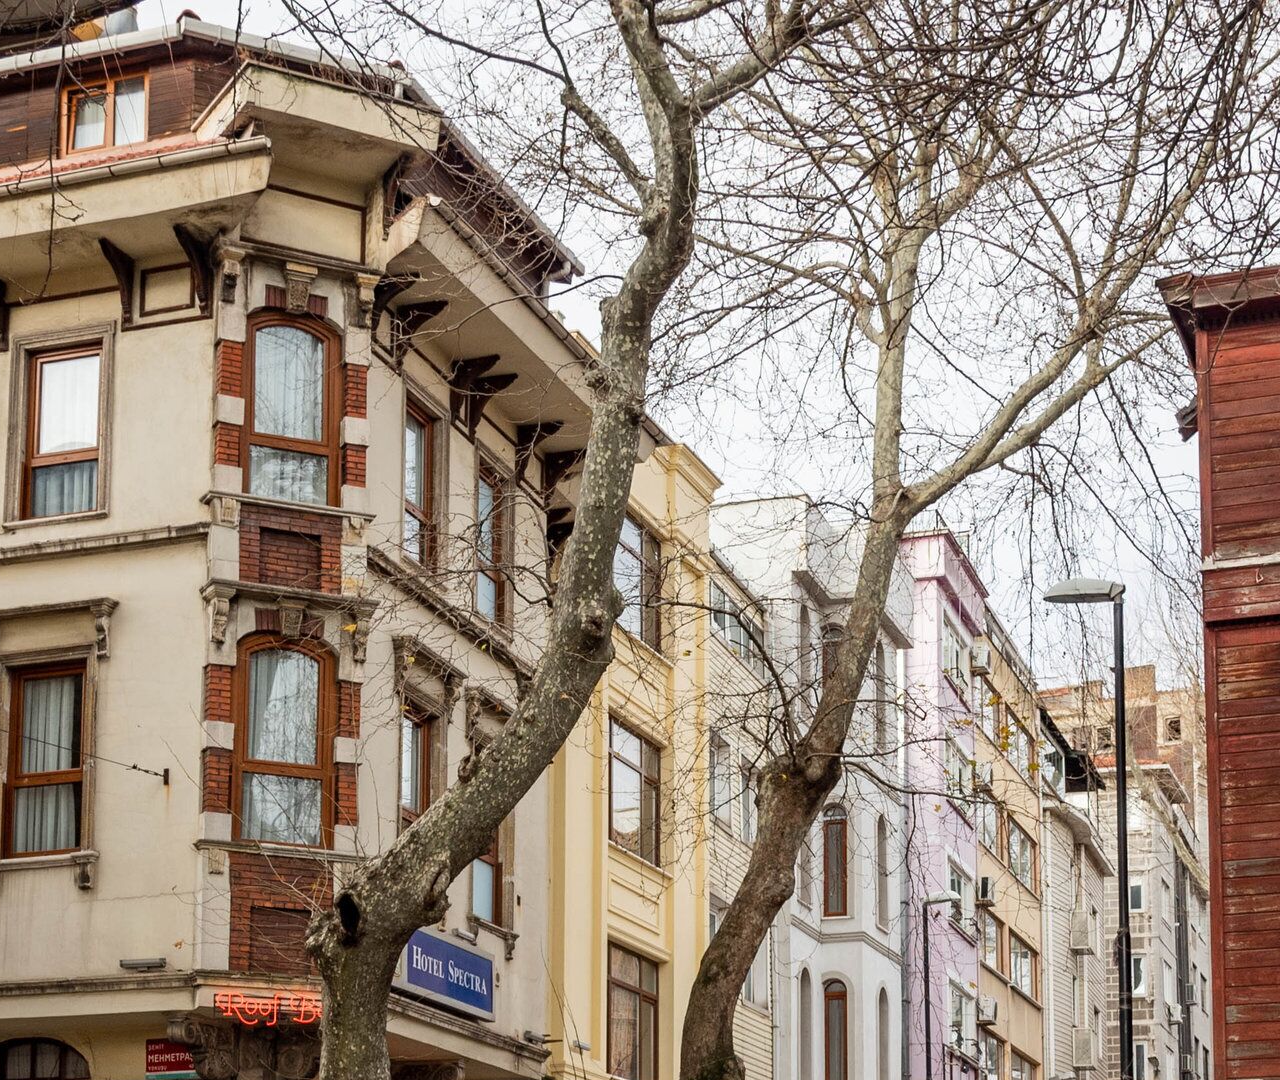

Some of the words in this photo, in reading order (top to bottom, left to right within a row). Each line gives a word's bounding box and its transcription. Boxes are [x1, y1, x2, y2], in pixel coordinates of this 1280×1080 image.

[412, 945, 445, 979] HOTEL
[448, 959, 487, 995] SPECTRA
[216, 992, 282, 1026] Roof
